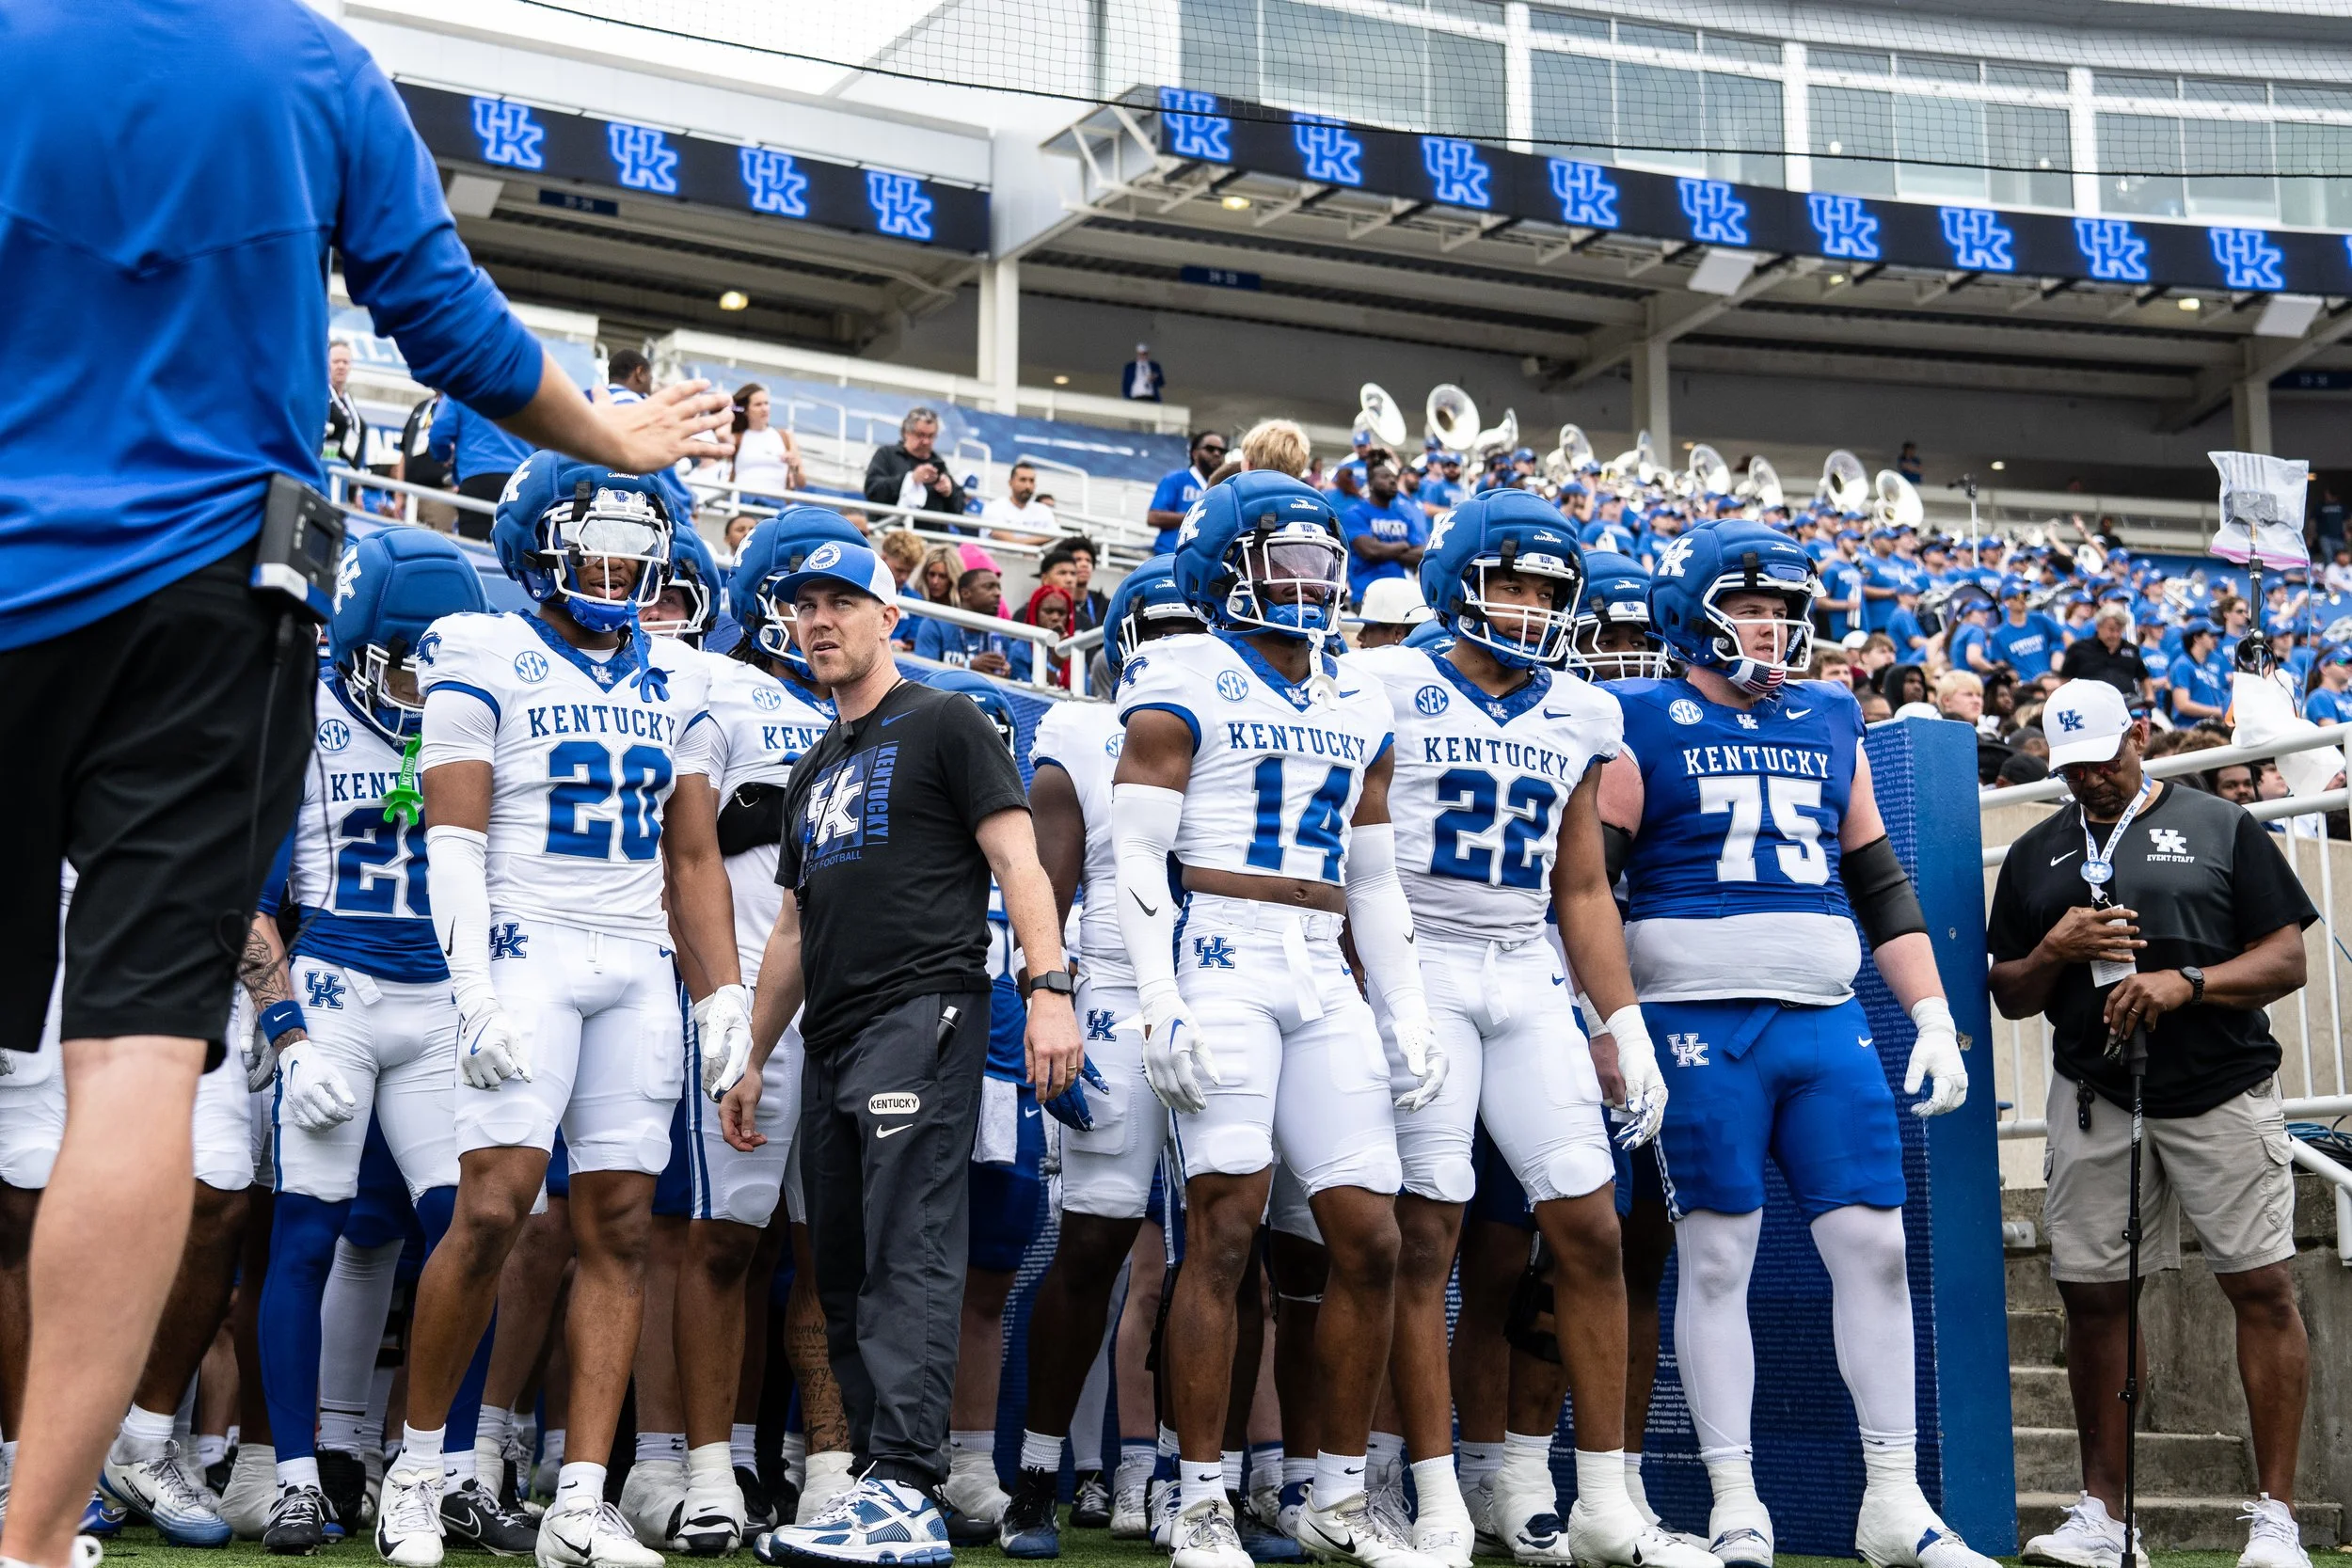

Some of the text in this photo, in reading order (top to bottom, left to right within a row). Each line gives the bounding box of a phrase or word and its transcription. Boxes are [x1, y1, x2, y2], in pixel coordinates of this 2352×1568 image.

[473, 98, 545, 169] UK
[1161, 87, 1231, 162] UK
[608, 122, 678, 194] UK
[1293, 114, 1361, 185] UK
[739, 139, 806, 217] UK
[1422, 138, 1489, 207] UK
[1549, 159, 1618, 228] UK
[866, 161, 932, 239] UK
[1678, 179, 1747, 245] UK
[1808, 194, 1880, 260] UK
[1940, 207, 2014, 271] UK
[2075, 219, 2148, 280] UK
[2209, 227, 2284, 289] UK
[516, 653, 548, 681] SEC
[1218, 673, 1248, 699] SEC
[753, 689, 781, 709] SEC
[1417, 689, 1448, 713] SEC
[1671, 702, 1703, 722] SEC
[320, 721, 350, 750] SEC
[528, 704, 676, 746] KENTUCKY
[763, 725, 827, 750] KENT
[1736, 714, 1759, 729] UK
[2058, 709, 2085, 732] UK
[1106, 736, 1124, 756] SE
[1228, 722, 1366, 764] KENTUCKY
[1423, 736, 1569, 781] KENTUCKY
[1683, 746, 1829, 780] KENTUCKY
[401, 756, 415, 787] NXTRND
[866, 746, 898, 836] KENTUCKY
[543, 739, 676, 863] 20
[1243, 755, 1355, 887] 14
[1427, 768, 1559, 893] 22
[1698, 775, 1831, 886] 75
[2149, 829, 2186, 854] UK
[819, 850, 862, 868] FOOTBALL
[2172, 855, 2195, 863] STAFF
[1194, 936, 1235, 969] UK
[305, 971, 345, 1009] UK
[1667, 1034, 1708, 1067] UK
[870, 1099, 917, 1110] KENTUCKY
